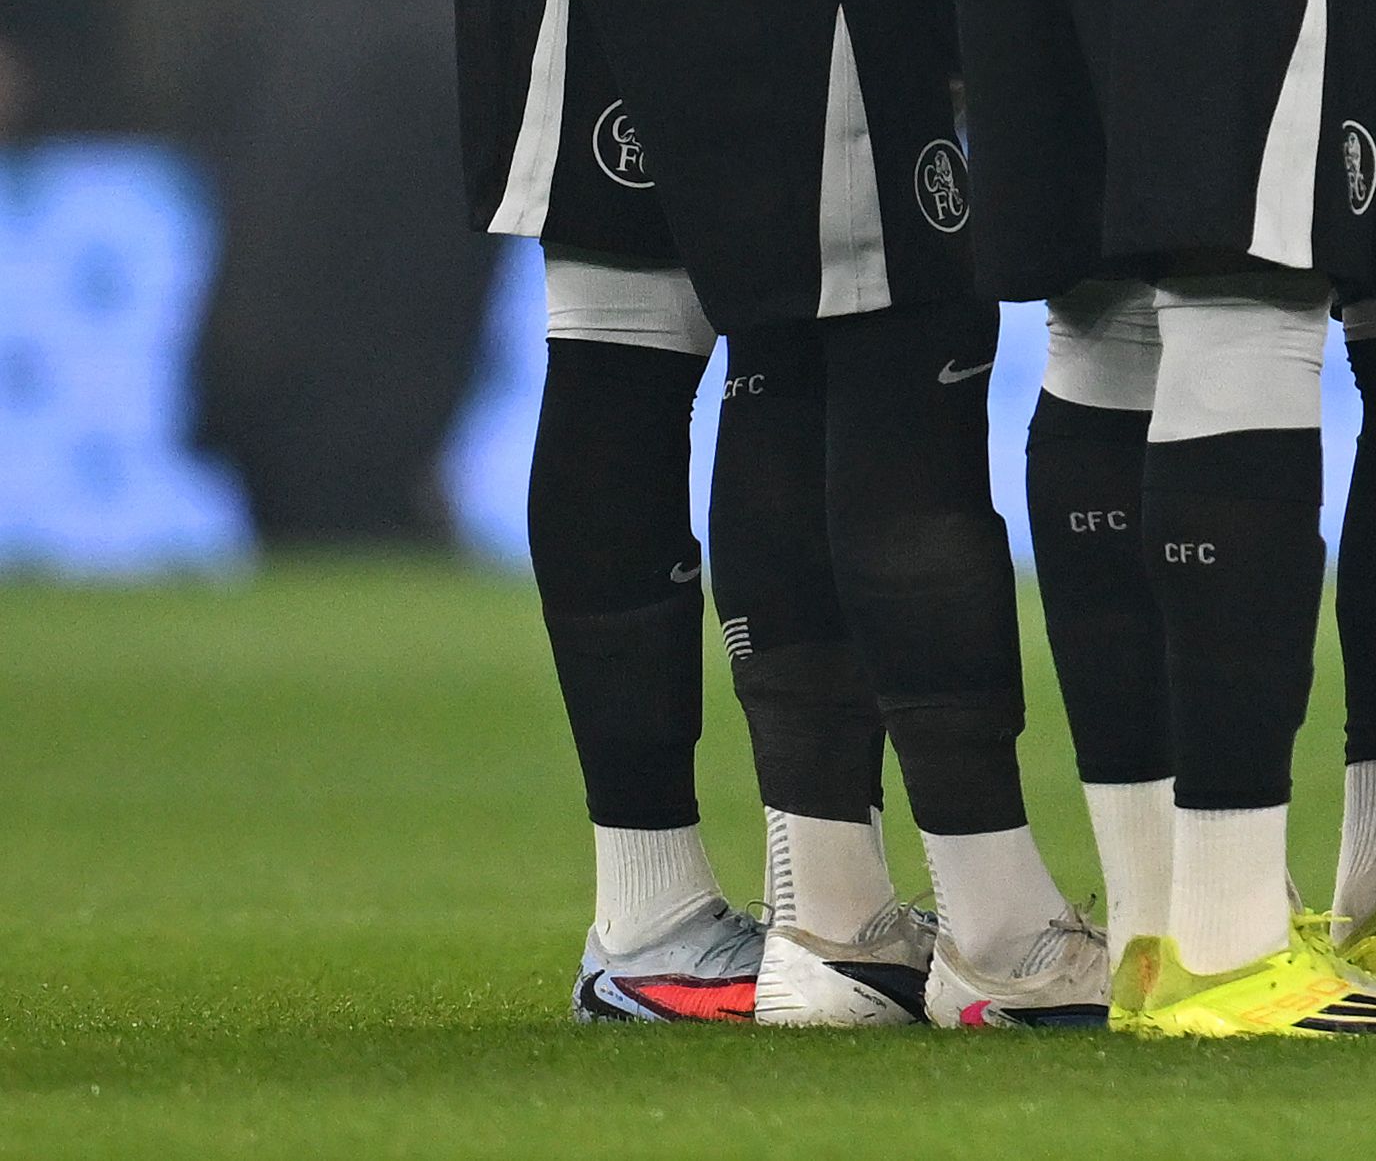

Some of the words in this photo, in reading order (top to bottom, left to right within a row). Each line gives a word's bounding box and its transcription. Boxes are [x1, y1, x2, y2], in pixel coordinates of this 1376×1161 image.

[723, 374, 765, 400] CFC
[1069, 510, 1127, 532] CFC
[1164, 542, 1216, 564] CFC
